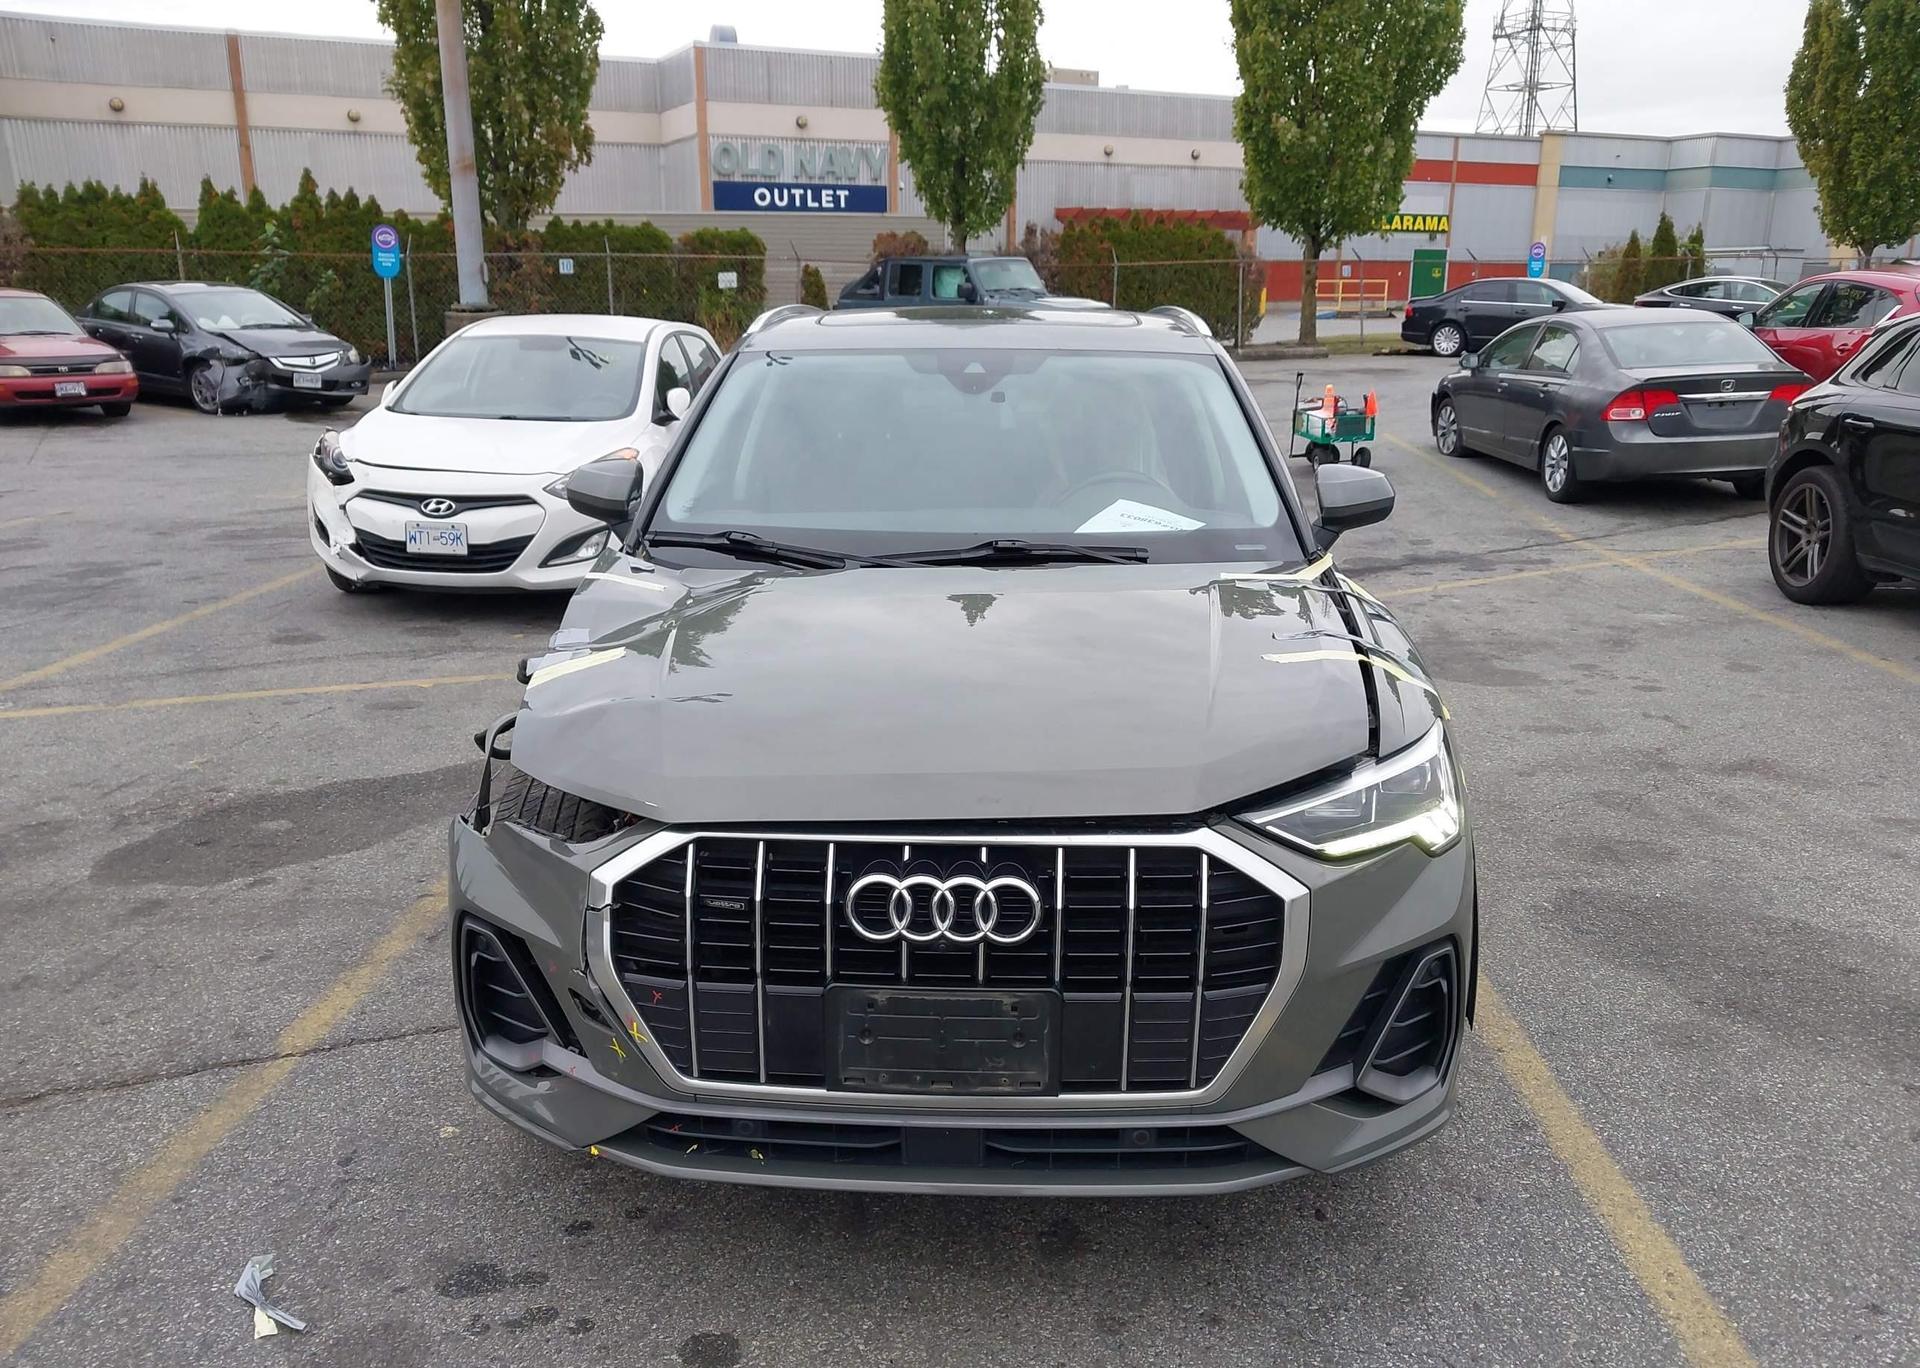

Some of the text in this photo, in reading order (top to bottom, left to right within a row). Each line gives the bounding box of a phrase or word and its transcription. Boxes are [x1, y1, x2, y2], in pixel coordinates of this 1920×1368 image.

[712, 141, 887, 181] OLD NAVY
[753, 187, 850, 208] OUTLET
[1373, 214, 1449, 232] LARAMA
